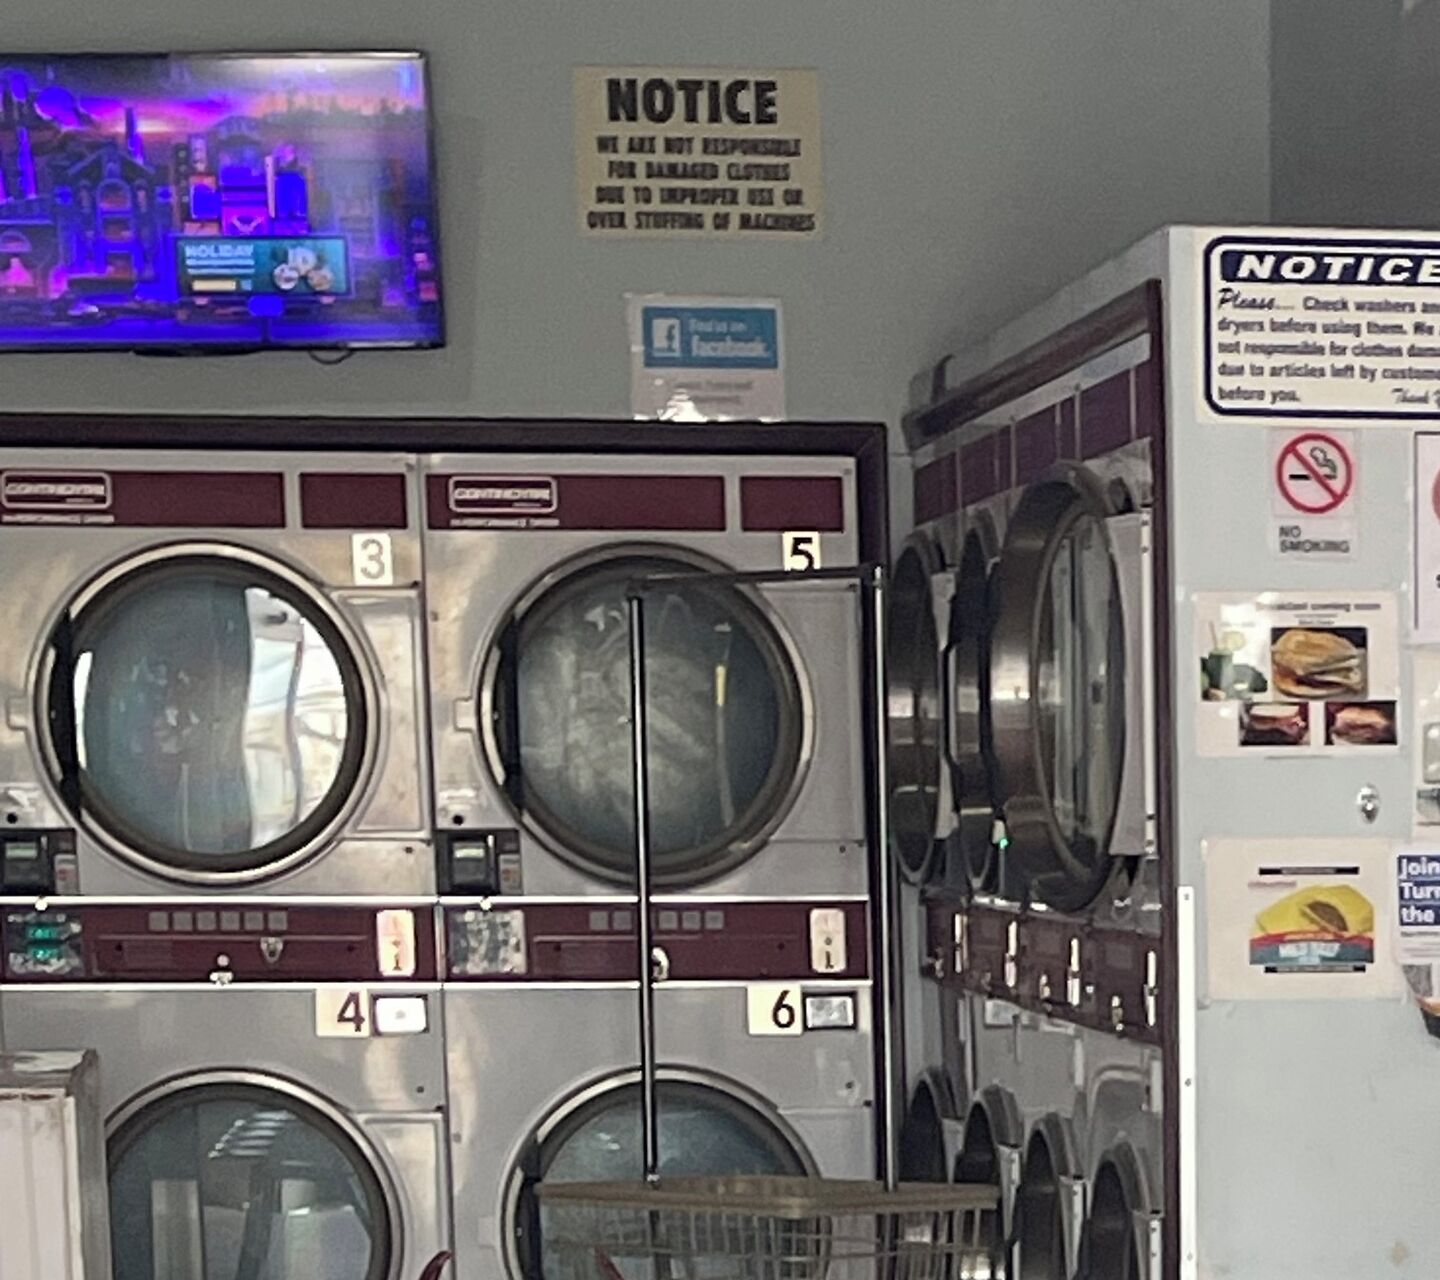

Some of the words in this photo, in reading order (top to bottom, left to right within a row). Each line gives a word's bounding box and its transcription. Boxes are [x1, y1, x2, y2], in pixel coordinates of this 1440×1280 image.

[607, 78, 777, 124] NOTICE
[597, 136, 618, 153] WE
[628, 136, 656, 154] ARE
[664, 137, 694, 154] NOT
[703, 138, 801, 156] RESPONSIBLE
[608, 161, 636, 179] FOR
[646, 162, 719, 179] DAMAGED
[727, 163, 790, 180] CLOTHES
[596, 186, 624, 203] DUE
[633, 186, 651, 204] TO
[660, 187, 738, 205] IMPROPER
[747, 188, 774, 205] USE
[588, 211, 626, 229] OVER
[635, 212, 704, 229] STUFFING
[713, 212, 730, 230] OF
[739, 213, 815, 231] MACHINES
[1303, 296, 1349, 312] Check
[1355, 299, 1416, 314] washers
[1218, 318, 1264, 335] dryers
[1270, 318, 1317, 333] before
[1322, 319, 1361, 337] using
[1367, 321, 1407, 335] them.
[1413, 321, 1434, 336] We
[1218, 341, 1241, 354] not
[1244, 341, 1325, 358] responsible
[1330, 341, 1347, 356] for
[1352, 343, 1403, 357] clothes
[1218, 363, 1244, 376] due
[1250, 364, 1263, 377] to
[1270, 363, 1325, 378] articles
[1330, 363, 1355, 378] left
[1359, 364, 1377, 382] by
[1218, 386, 1265, 400] before
[1270, 389, 1301, 404] you.
[1279, 525, 1301, 538] NO
[788, 536, 815, 571] 5
[1279, 540, 1350, 553] SMOKING
[360, 539, 385, 579] 3
[1401, 857, 1440, 877] Join
[1401, 906, 1435, 923] the
[337, 992, 365, 1032] 4
[772, 990, 795, 1028] 6
